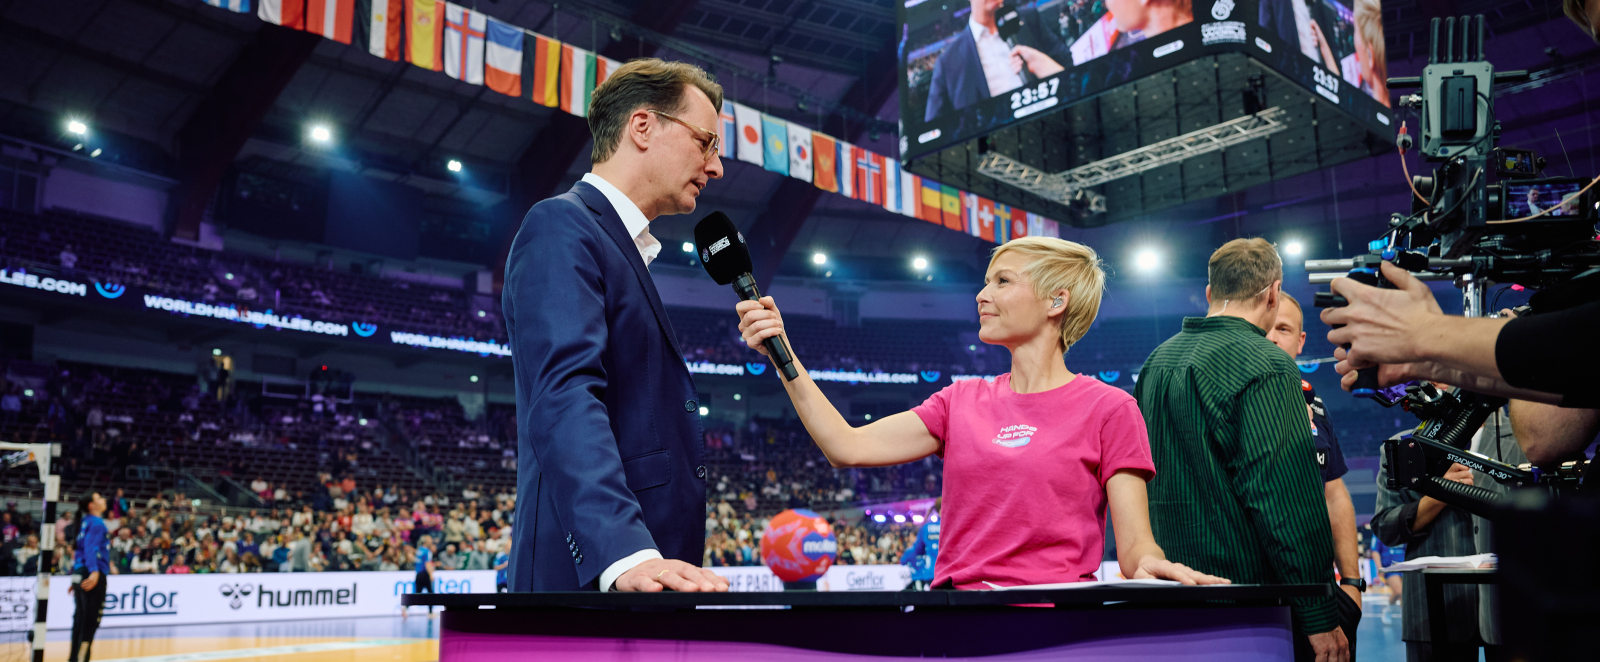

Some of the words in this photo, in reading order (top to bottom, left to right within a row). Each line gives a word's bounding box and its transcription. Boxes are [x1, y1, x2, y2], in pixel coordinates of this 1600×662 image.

[1010, 77, 1060, 110] 23:57
[143, 294, 348, 337] WORLDHANDBALLES.COM
[1000, 424, 1037, 433] HANDS
[1012, 430, 1034, 438] FOR
[104, 585, 178, 613] erflor
[258, 582, 357, 608] hummel
[394, 577, 472, 596] mlten
